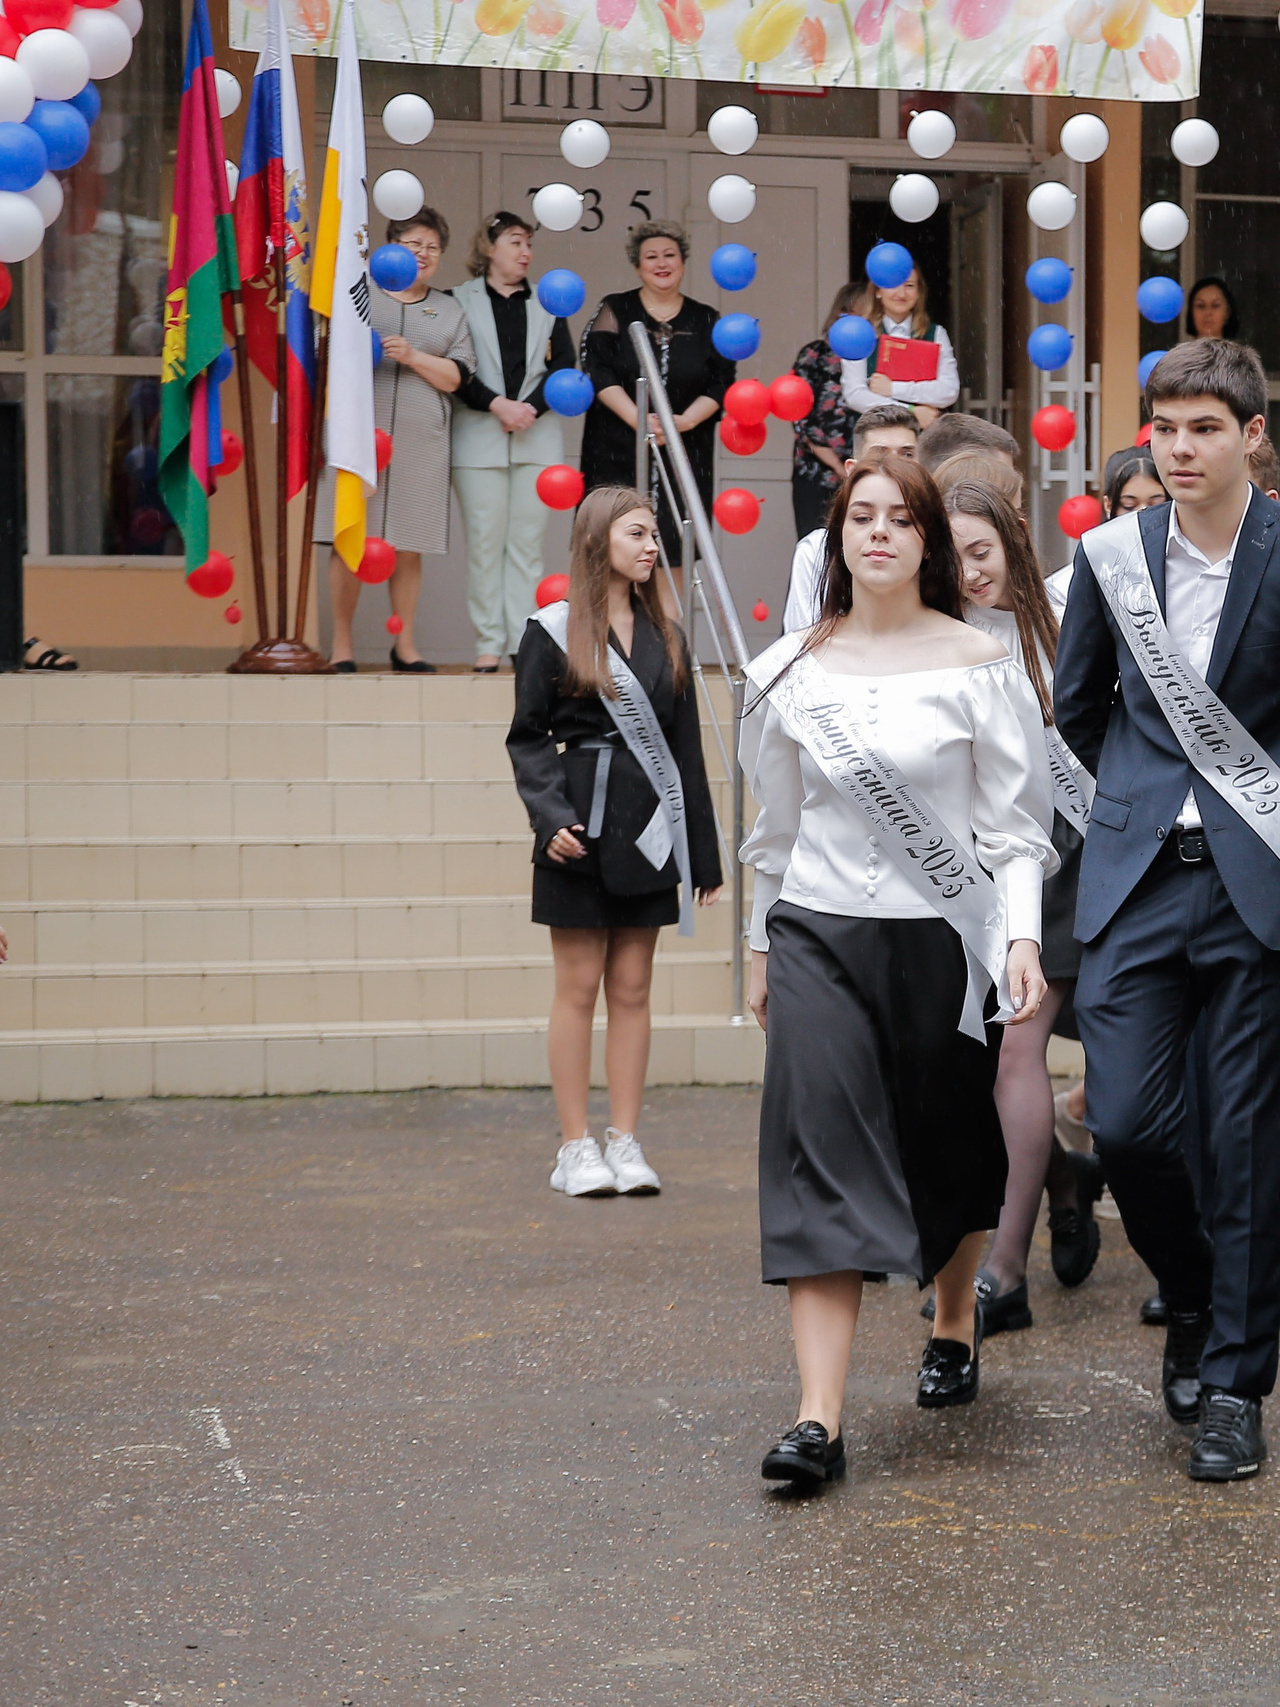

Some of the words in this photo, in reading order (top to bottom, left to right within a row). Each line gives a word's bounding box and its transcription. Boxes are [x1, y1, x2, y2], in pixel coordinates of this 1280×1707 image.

[526, 187, 651, 232] 35
[1124, 583, 1233, 755] Выпускник
[1205, 699, 1233, 734] Иван
[803, 687, 922, 840] Выпускница
[905, 835, 976, 899] 2023
[890, 783, 932, 827] Анастасия
